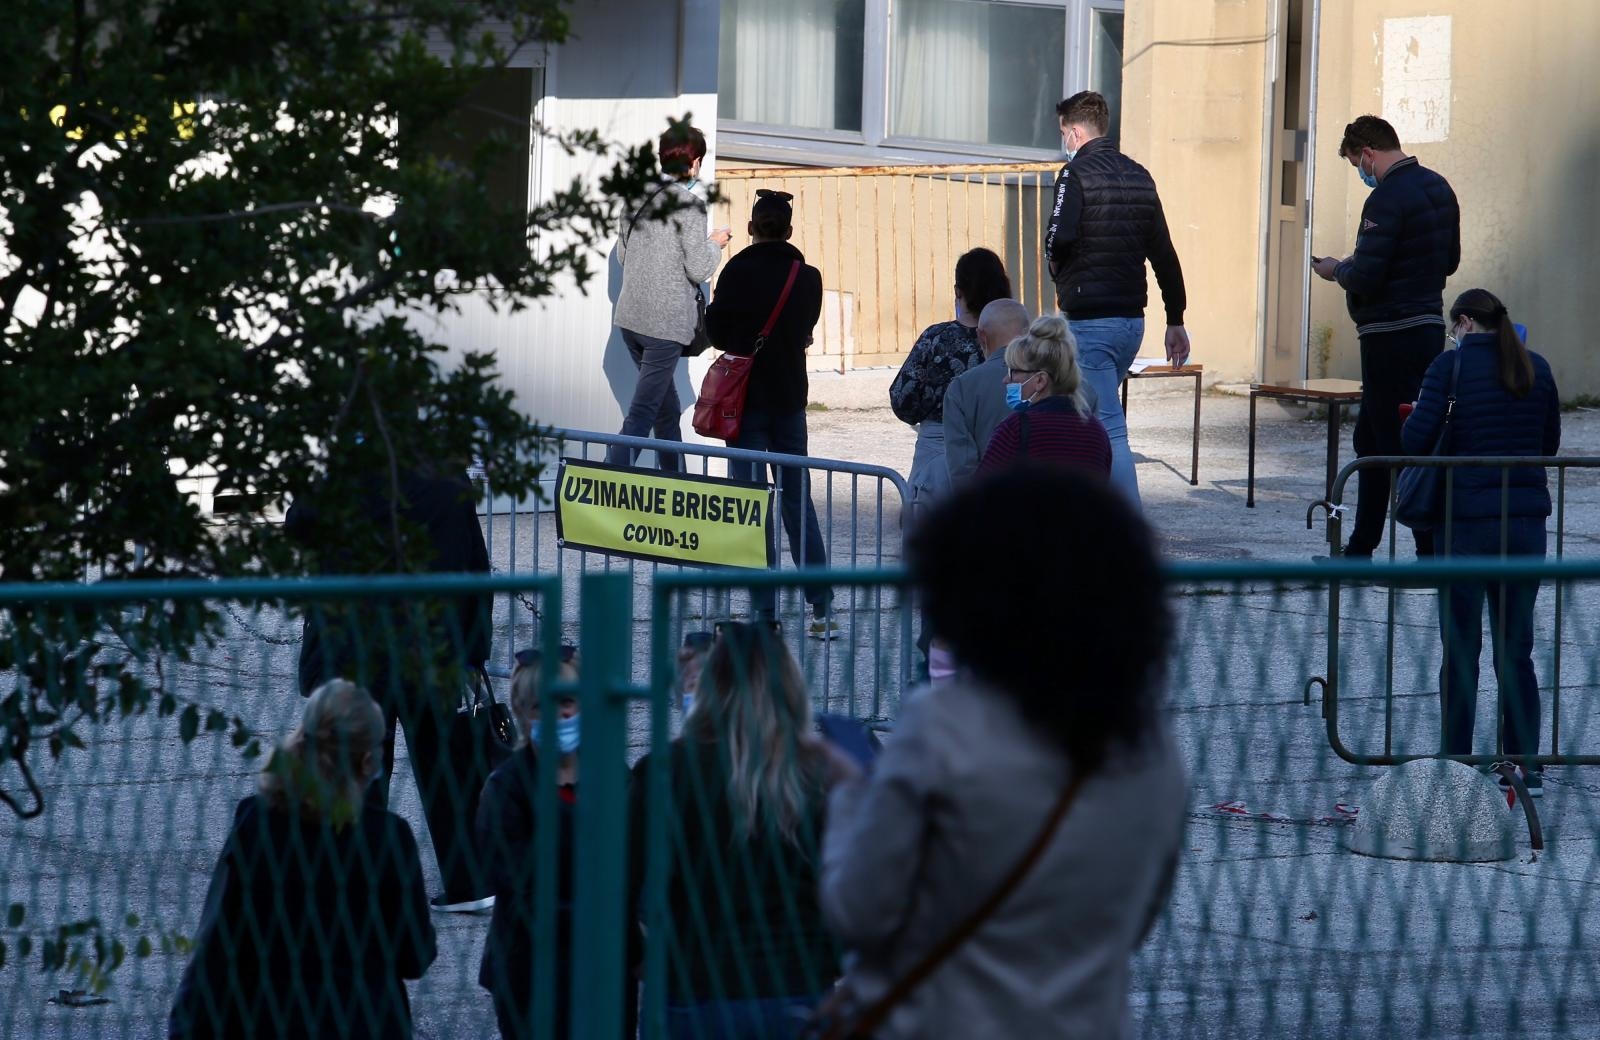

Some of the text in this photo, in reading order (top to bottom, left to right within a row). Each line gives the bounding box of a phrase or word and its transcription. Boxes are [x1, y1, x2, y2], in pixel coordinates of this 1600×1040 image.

[564, 476, 761, 527] UZIMANJE BRISEVA
[623, 523, 699, 551] COVID-19
